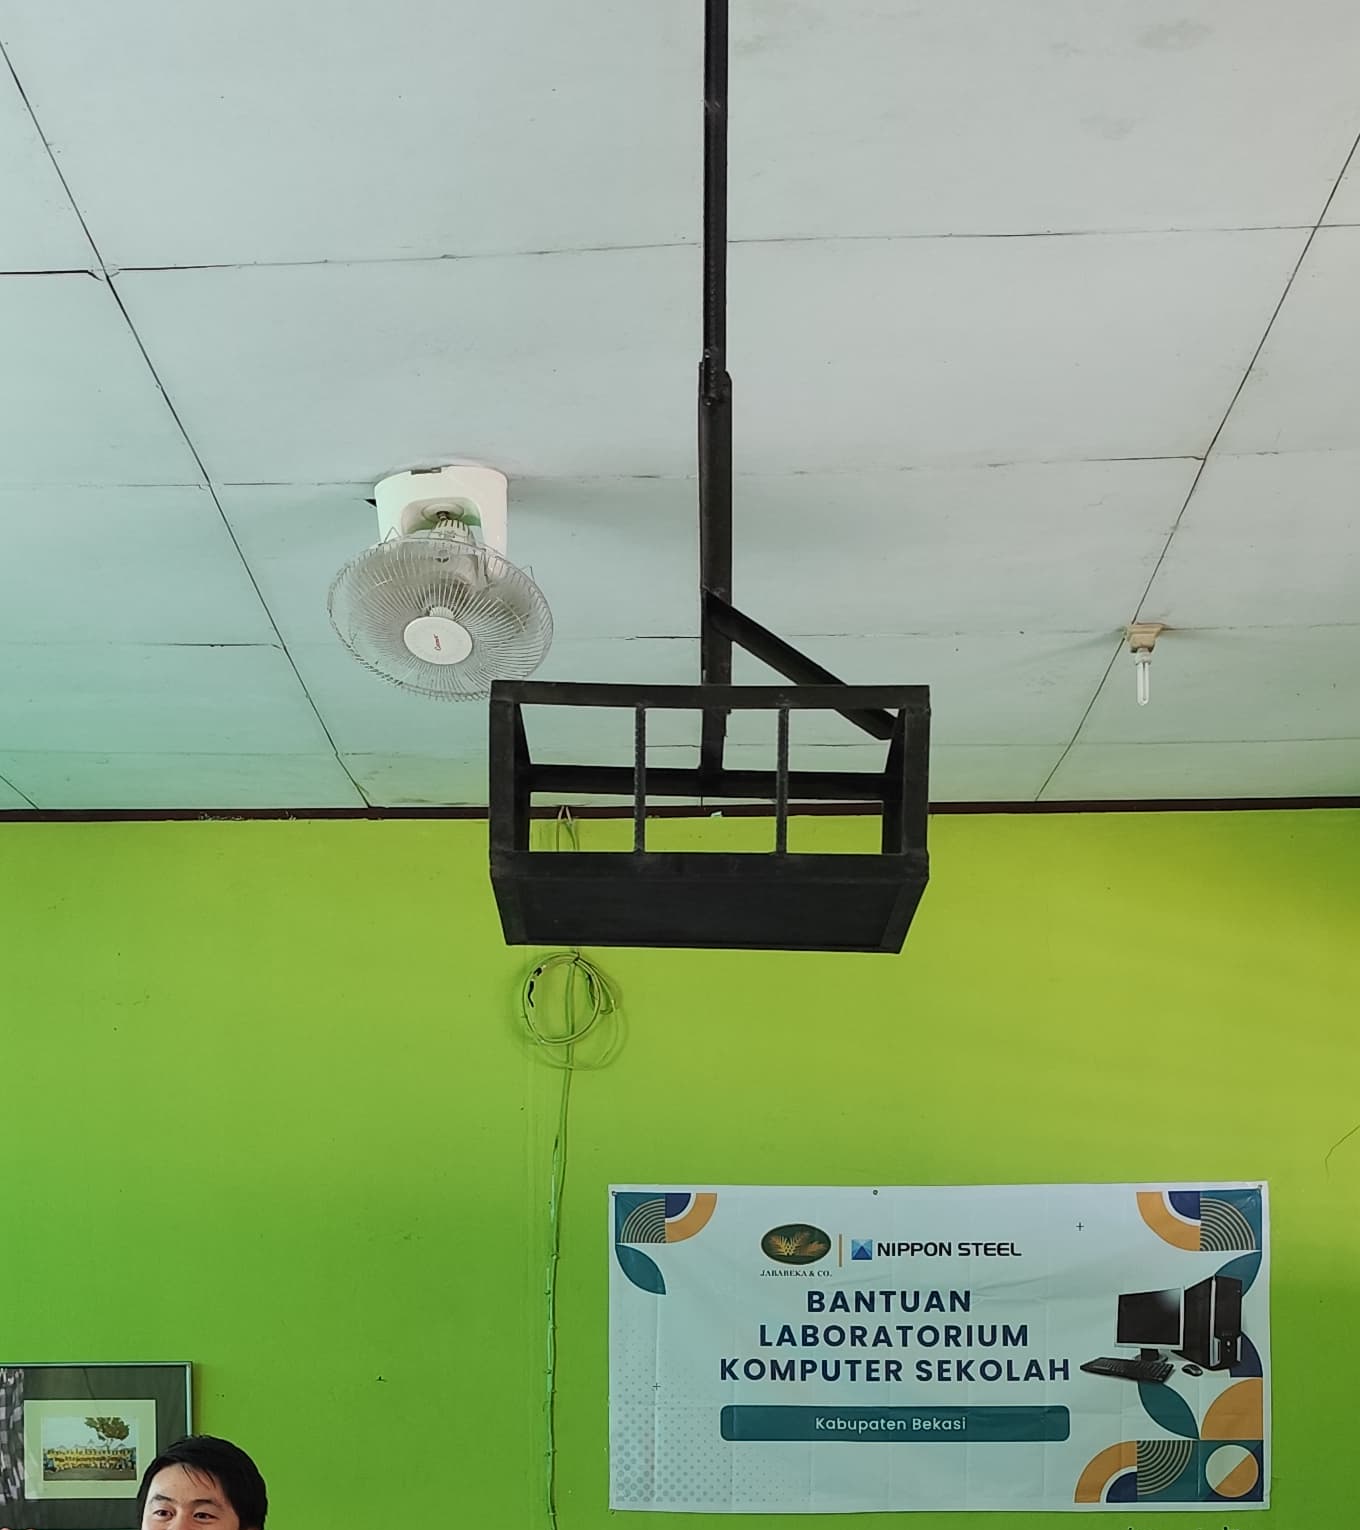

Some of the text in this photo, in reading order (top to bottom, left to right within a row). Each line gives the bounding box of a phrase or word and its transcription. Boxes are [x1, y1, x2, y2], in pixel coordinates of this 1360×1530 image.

[877, 1241, 1022, 1257] NIPPON STEEL
[759, 1269, 807, 1277] JABABEKA
[807, 1290, 971, 1313] BANTUAN
[759, 1324, 1029, 1348] LABORATORIUM
[720, 1358, 1070, 1382] KOMPUTER SEKOLAH
[814, 1416, 967, 1435] Kabupaten Bekasi
